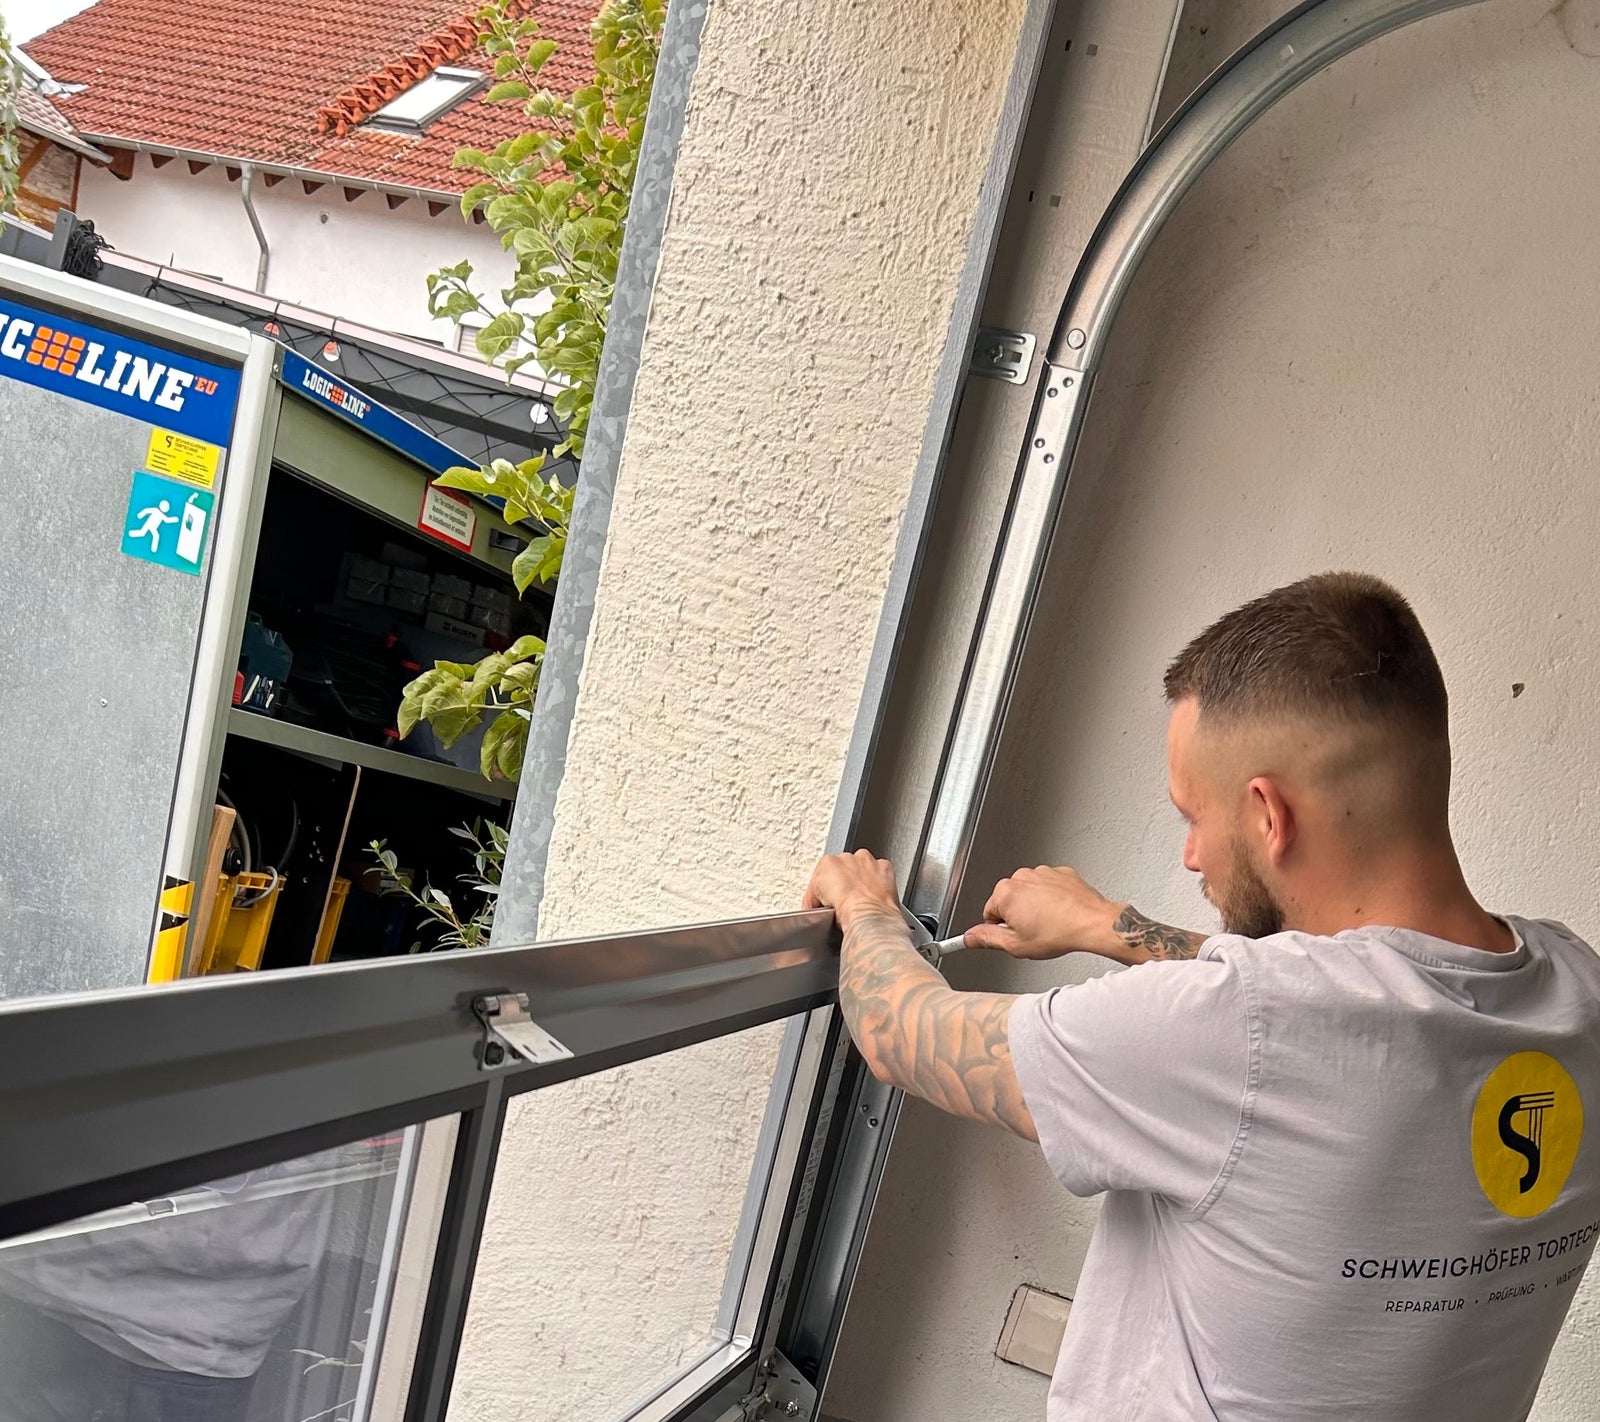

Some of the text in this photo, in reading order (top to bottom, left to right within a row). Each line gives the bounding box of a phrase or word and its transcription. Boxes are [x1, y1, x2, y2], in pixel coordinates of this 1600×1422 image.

[75, 342, 195, 412] LINE
[302, 368, 367, 419] LOGIC LINE
[1341, 1246, 1531, 1279] SCHWEIGHÖFER
[1385, 1298, 1465, 1313] REPARATUR
[1488, 1283, 1536, 1304] PRÜFUNG
